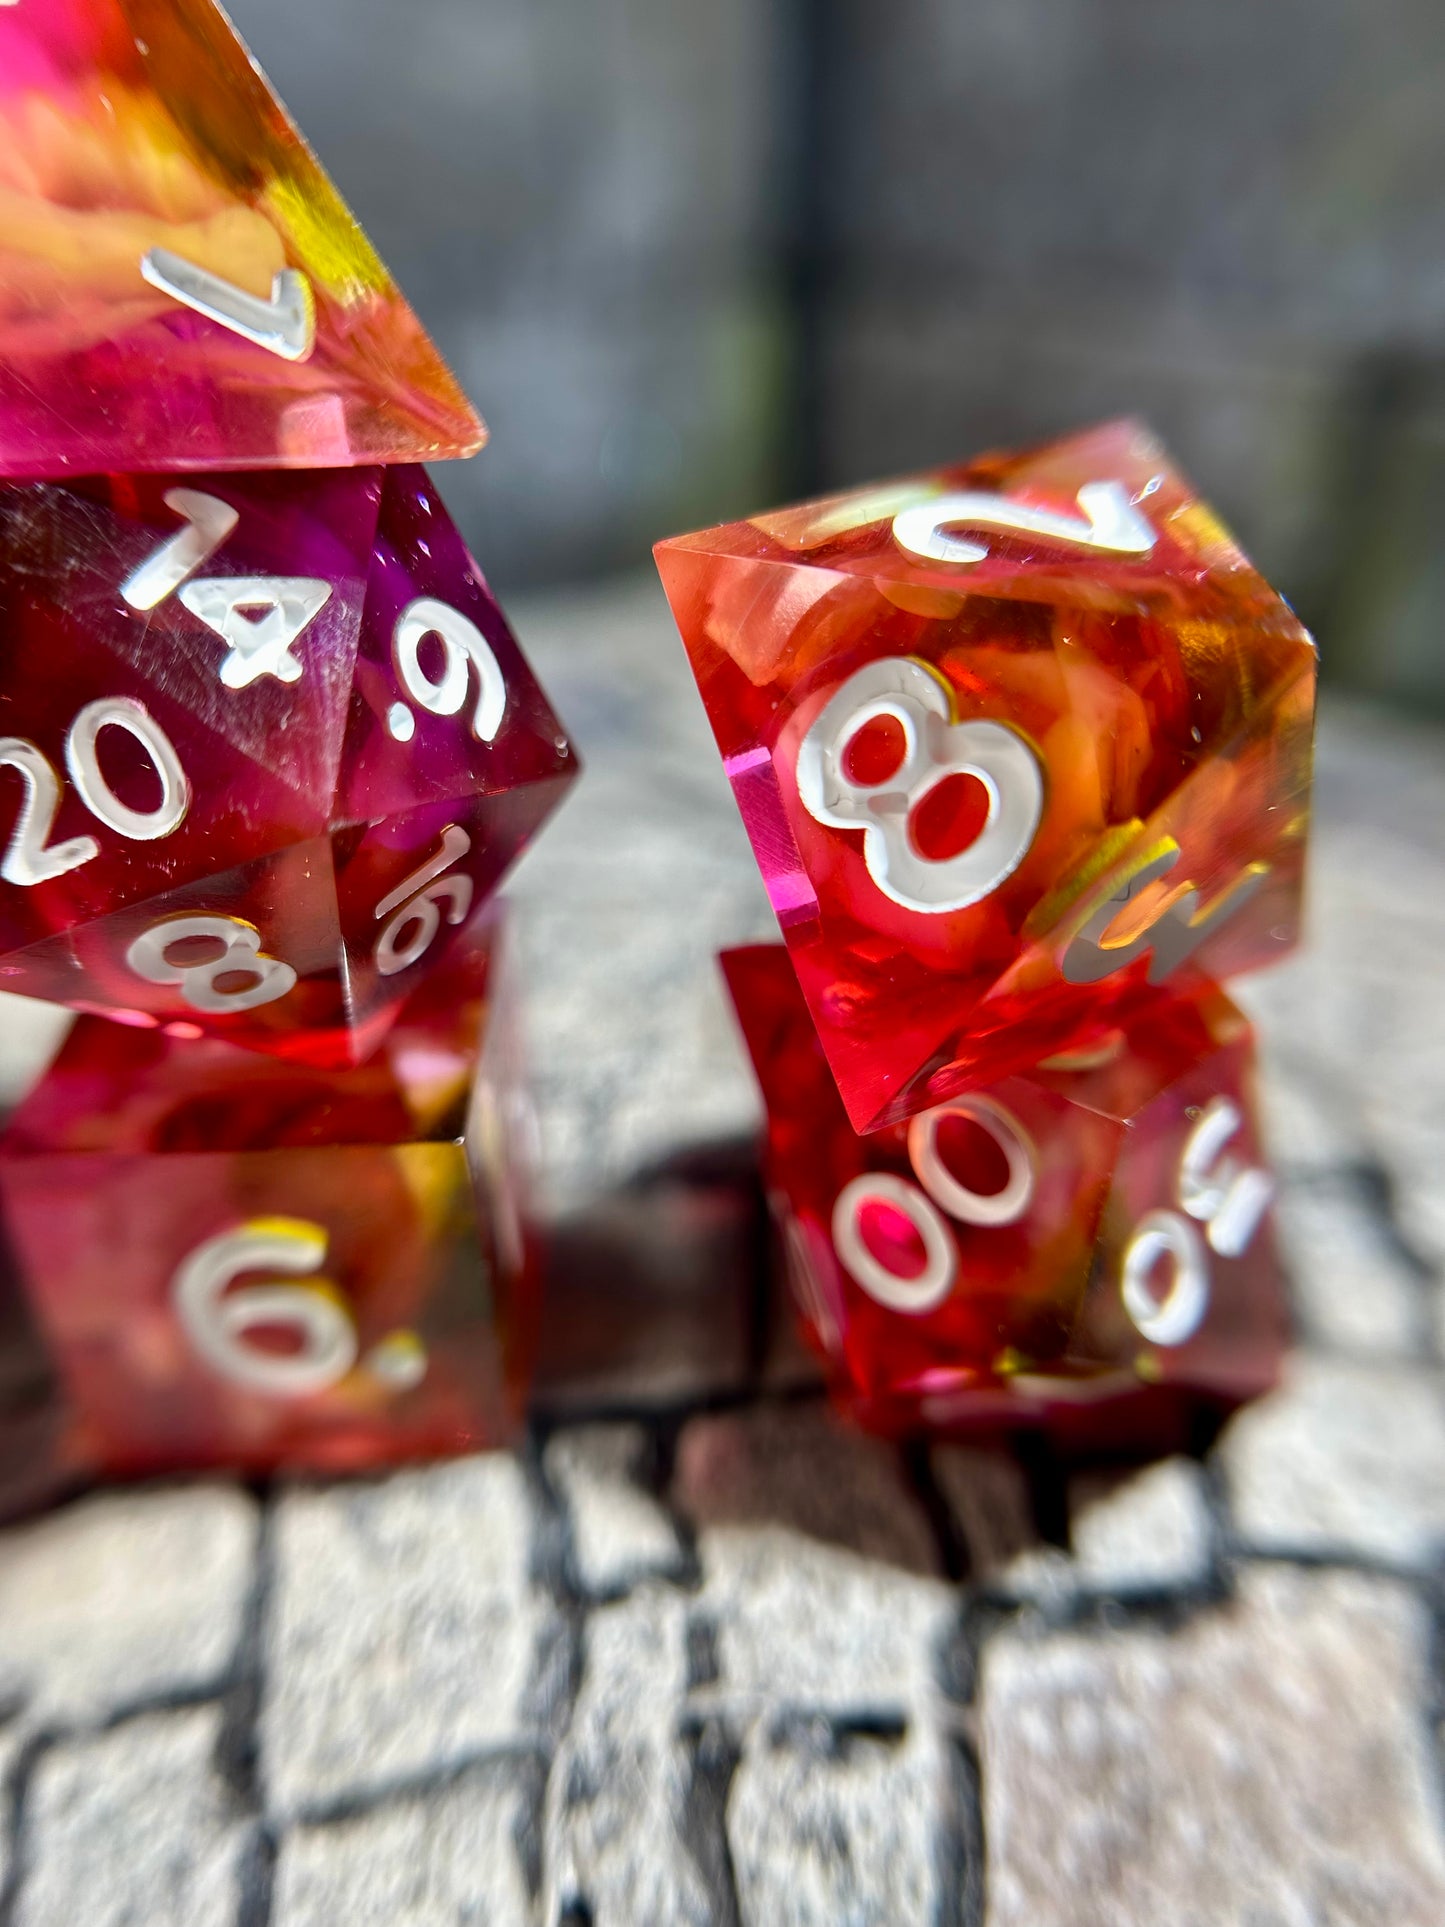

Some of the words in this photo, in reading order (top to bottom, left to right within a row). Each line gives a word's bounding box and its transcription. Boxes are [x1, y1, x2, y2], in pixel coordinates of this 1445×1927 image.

[891, 480, 1158, 563] 2
[0, 695, 192, 886] 20
[797, 655, 1045, 915] 8
[127, 909, 297, 1013] 8
[832, 1093, 1036, 1315] 00
